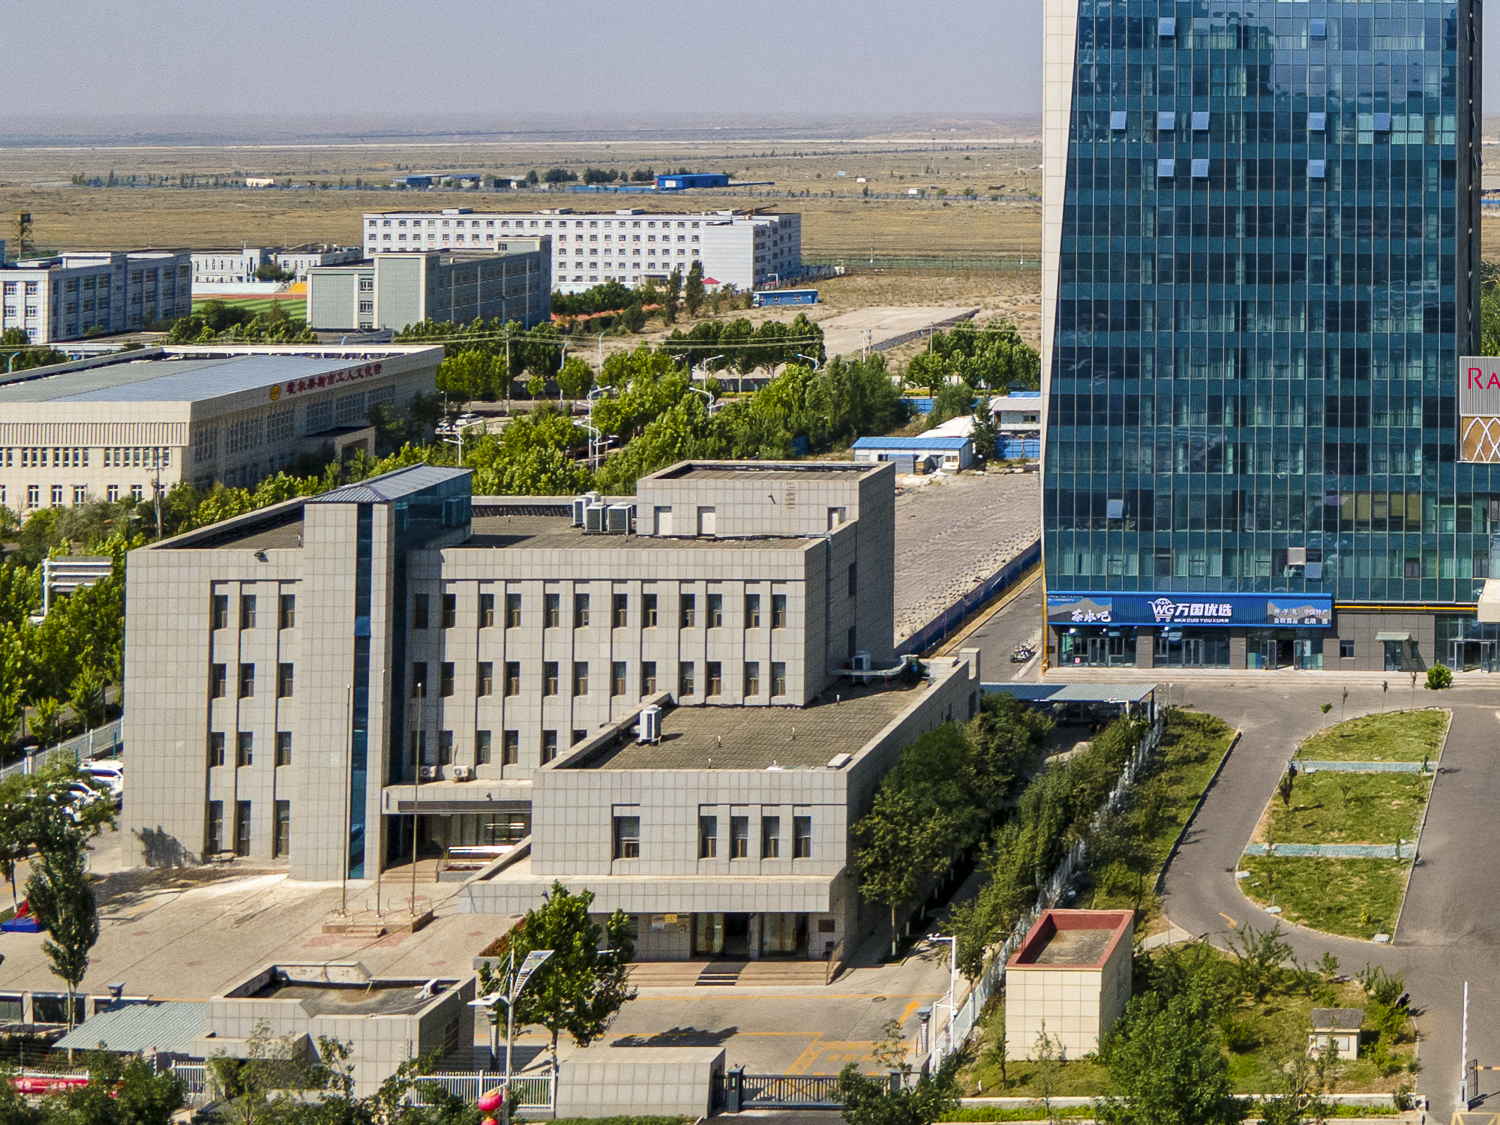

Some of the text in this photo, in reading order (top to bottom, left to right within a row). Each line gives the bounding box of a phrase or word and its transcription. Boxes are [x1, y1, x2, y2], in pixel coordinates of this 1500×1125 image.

[1071, 608, 1112, 623] 茶水吧
[1175, 603, 1232, 616] 万国优选
